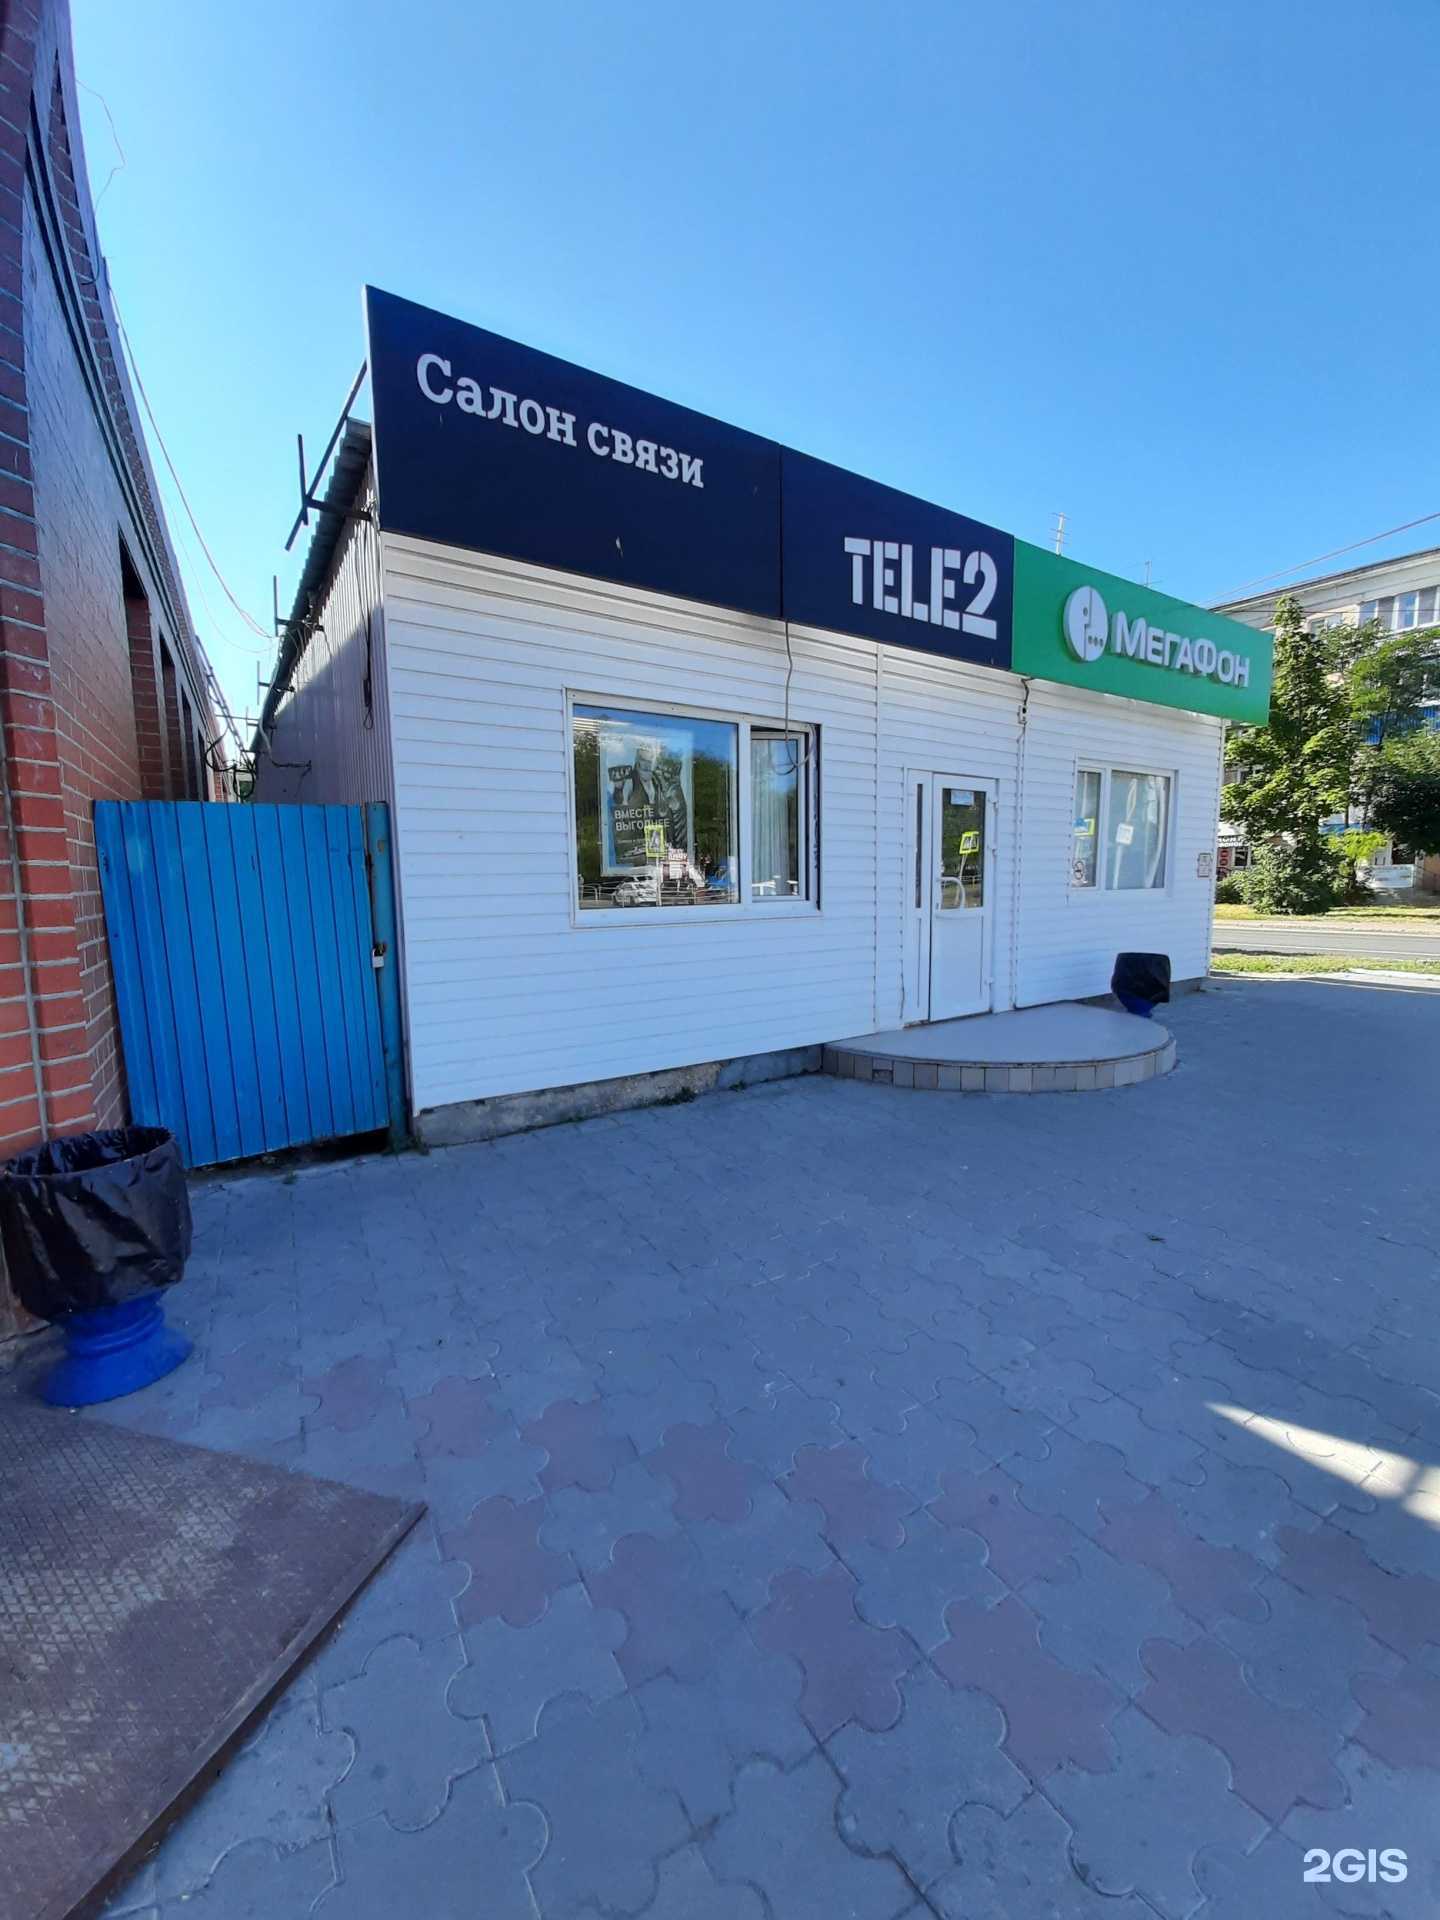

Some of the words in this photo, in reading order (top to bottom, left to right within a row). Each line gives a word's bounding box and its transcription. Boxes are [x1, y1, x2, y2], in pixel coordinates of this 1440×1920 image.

[416, 353, 576, 446] Салон
[587, 422, 704, 488] связи
[844, 537, 998, 639] TELE2
[614, 808, 655, 819] ВМЕСТЕ
